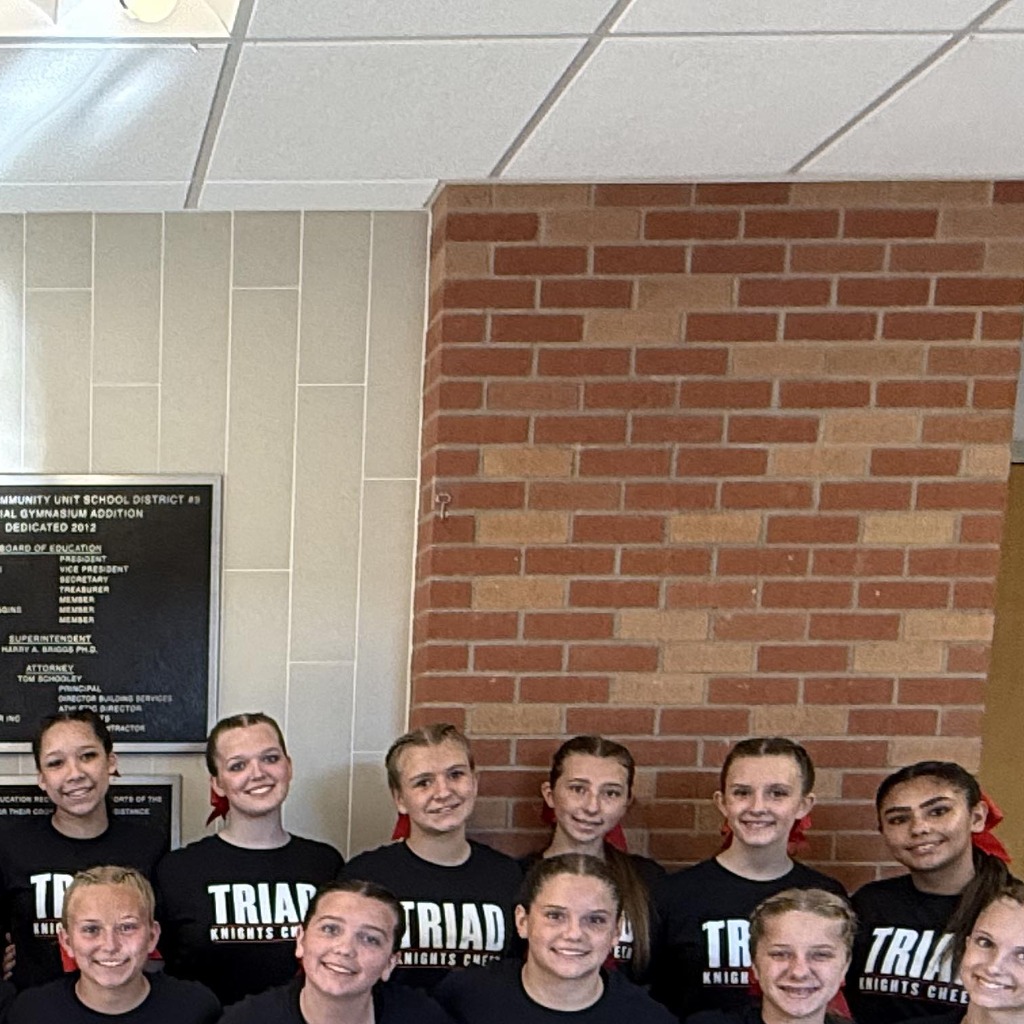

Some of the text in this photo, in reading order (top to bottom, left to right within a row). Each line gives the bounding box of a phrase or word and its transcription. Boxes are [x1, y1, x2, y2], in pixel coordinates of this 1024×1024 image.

[54, 495, 80, 505] UNIT
[83, 495, 129, 505] SCHOOL
[133, 495, 184, 505] DISTRICT
[20, 509, 87, 518] GYMNASIUM
[90, 509, 144, 518] ADDITION
[5, 522, 97, 532] DEDICATED 2012
[0, 544, 102, 553] BOARD OF EDUCATION
[59, 555, 107, 563] PRESIDENT
[59, 565, 129, 573] VICE PRESIDENT
[59, 616, 95, 624] MEMBER
[8, 634, 92, 643] SUPERINTENDENT
[26, 664, 74, 673] ATTORNEY
[399, 901, 505, 951] TRIAD
[210, 927, 274, 940] KNIGHTS
[864, 927, 965, 986] TRIA
[703, 971, 749, 984] KNIGH
[859, 977, 968, 1004] KNIGHTS CHEE
